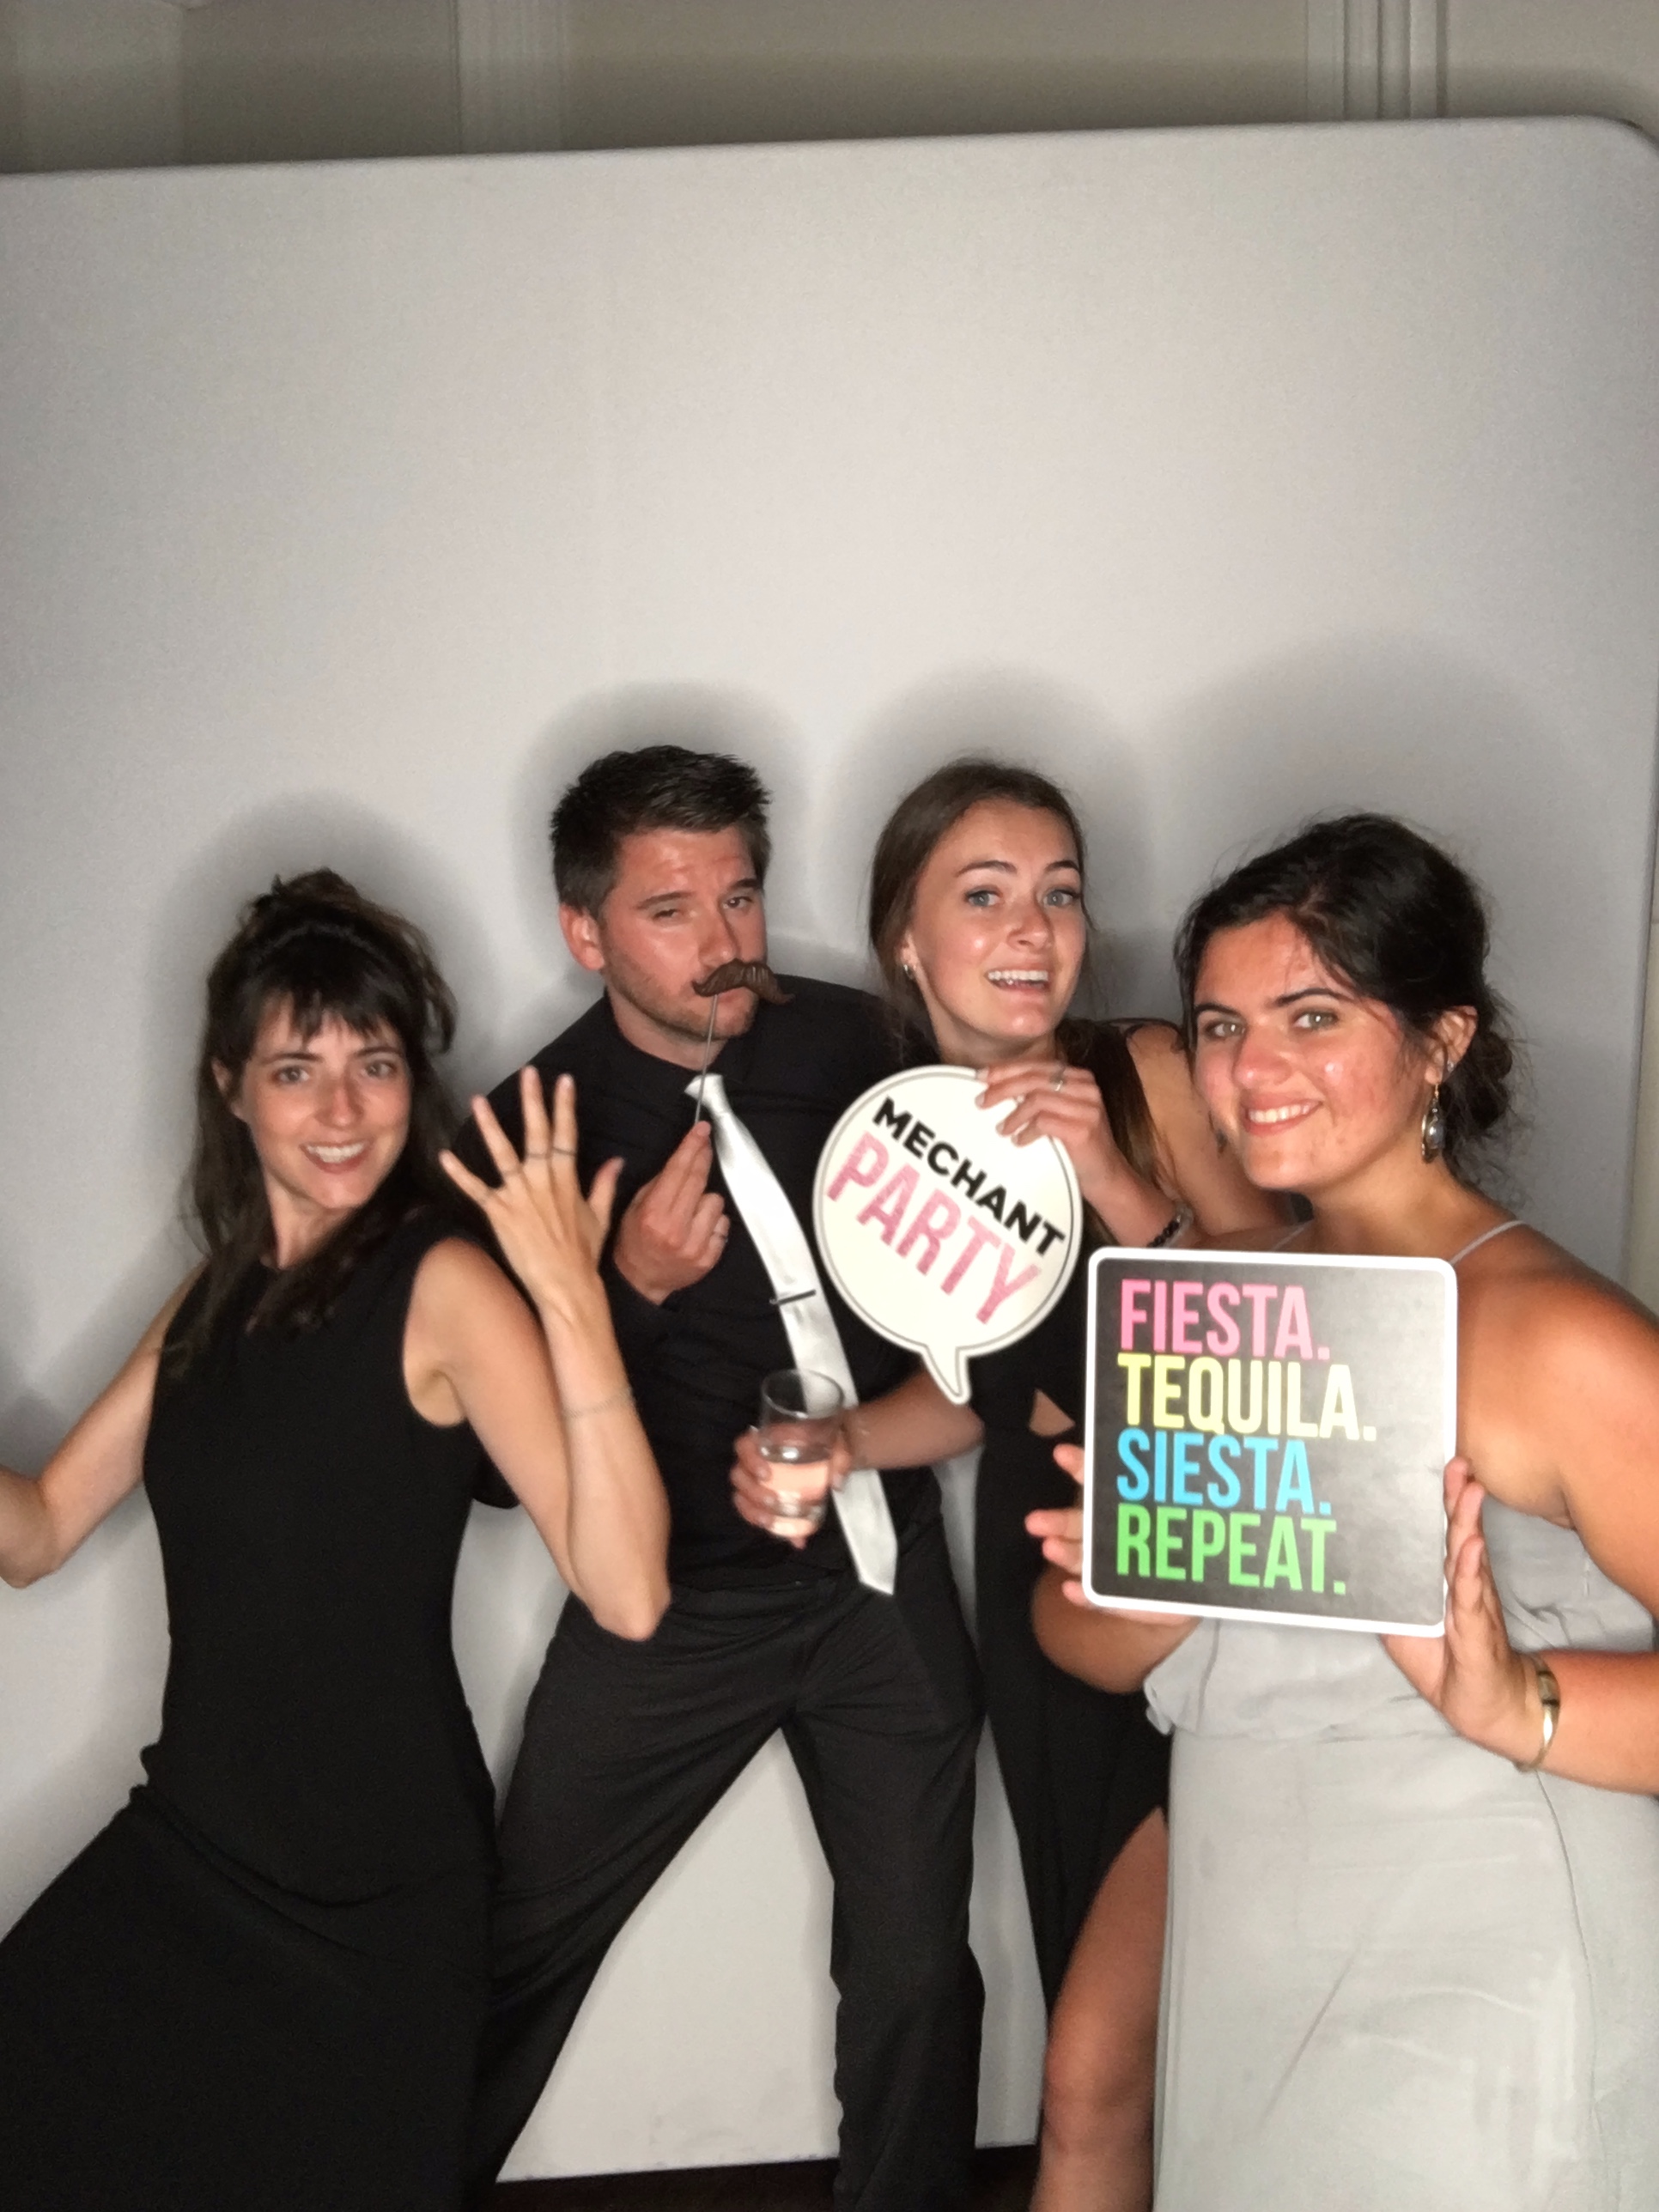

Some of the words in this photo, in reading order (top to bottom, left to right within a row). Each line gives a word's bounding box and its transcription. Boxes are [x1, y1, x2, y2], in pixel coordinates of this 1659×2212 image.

[872, 1095, 1066, 1256] MECHANT
[826, 1130, 1042, 1325] PARTY
[1121, 1279, 1330, 1360] FIESTA.
[1117, 1352, 1376, 1442] TEQUILA.
[1116, 1427, 1332, 1516] SIESTA.
[1116, 1502, 1346, 1595] REPEAT.
